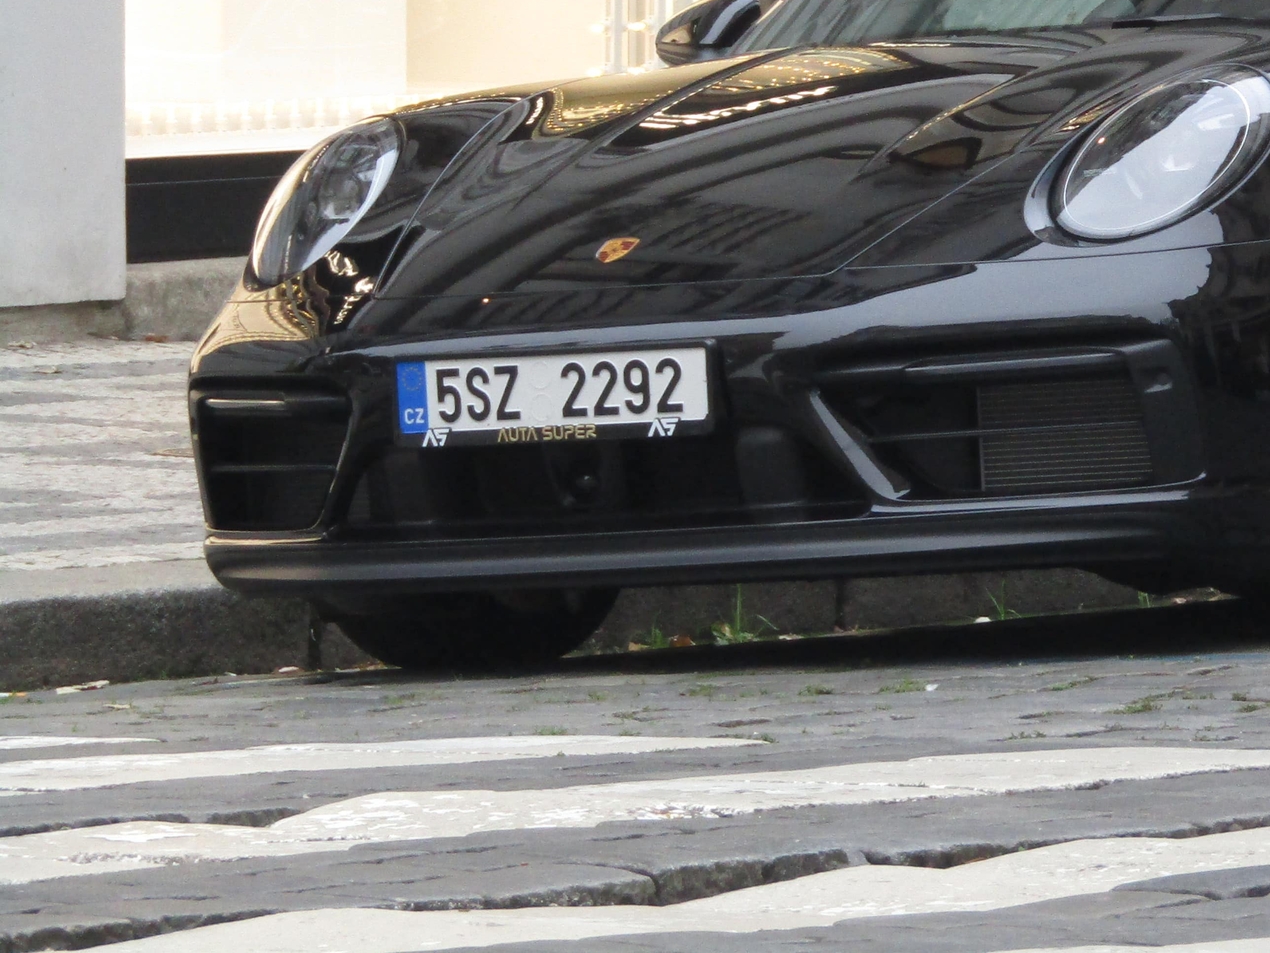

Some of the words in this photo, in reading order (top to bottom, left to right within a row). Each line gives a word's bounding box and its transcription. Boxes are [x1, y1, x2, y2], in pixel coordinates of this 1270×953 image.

[436, 364, 521, 423] 5SZ
[561, 357, 684, 418] 2292
[404, 407, 425, 425] CZ
[498, 427, 538, 443] AUTA
[542, 424, 597, 441] SUPER
